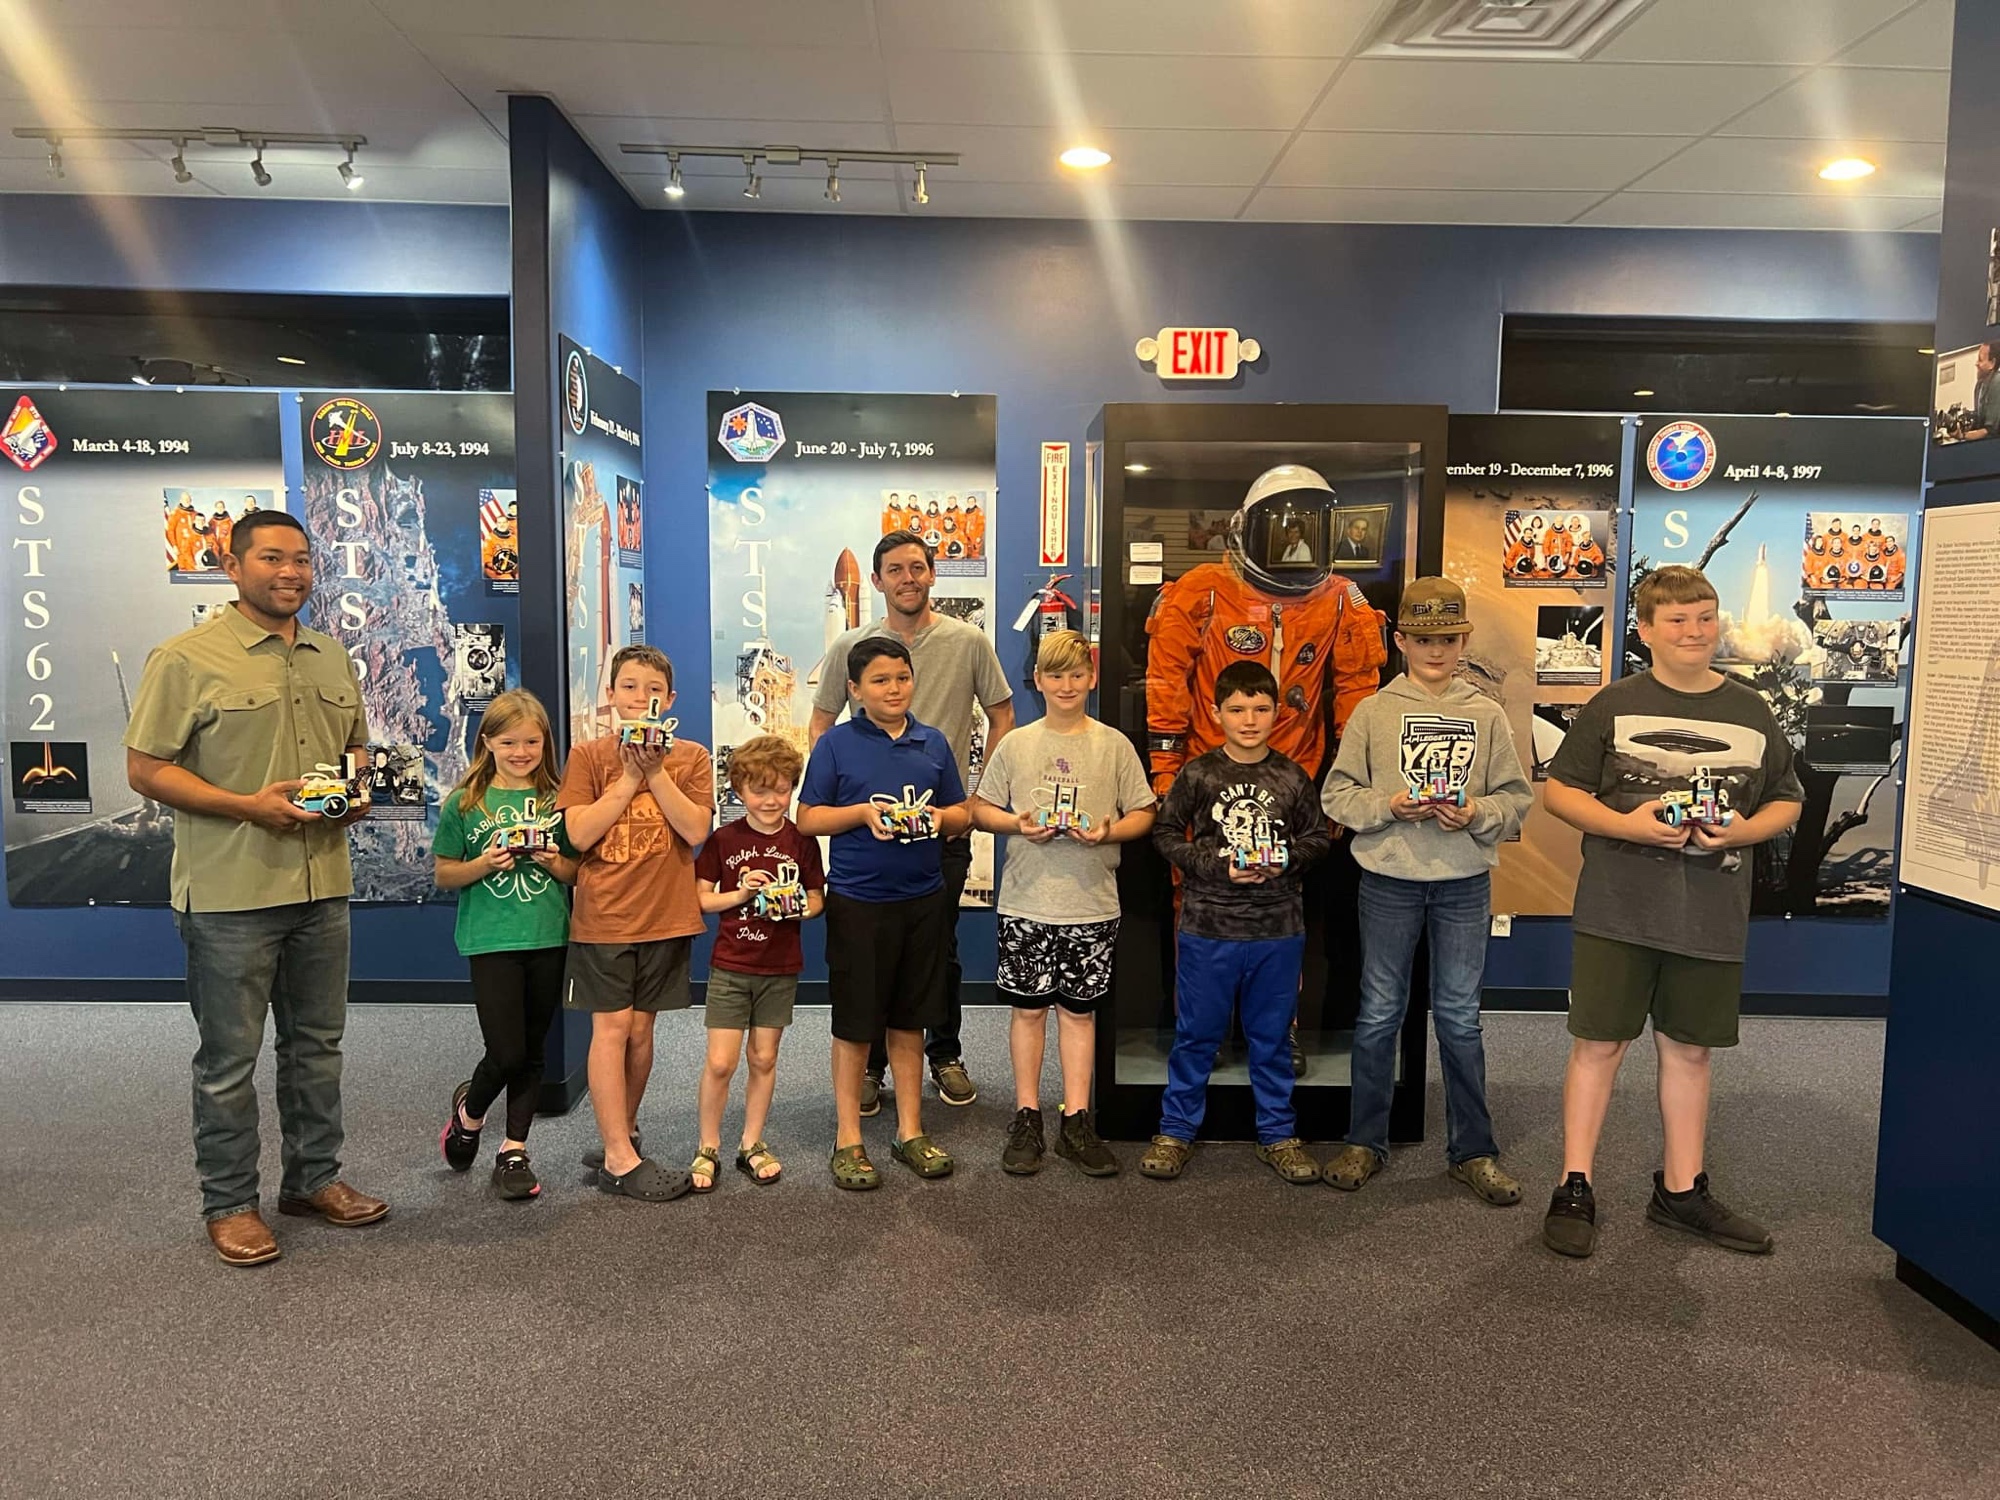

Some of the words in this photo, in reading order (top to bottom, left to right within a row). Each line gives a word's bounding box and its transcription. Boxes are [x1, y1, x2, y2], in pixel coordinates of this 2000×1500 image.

[1172, 331, 1228, 374] EXIT
[72, 438, 119, 453] March
[121, 439, 156, 455] 4-18,
[158, 439, 190, 454] 1994
[390, 441, 419, 459] July
[422, 441, 457, 457] 8-23,
[459, 441, 490, 456] 1994
[795, 441, 828, 458] June
[830, 441, 847, 455] 20
[858, 441, 887, 459] July
[889, 442, 901, 459] 7,
[904, 442, 934, 456] 1996
[1046, 452, 1064, 464] FIRE
[1446, 462, 1486, 476] ember
[1488, 462, 1501, 476] 19
[1510, 462, 1573, 477] December
[1574, 463, 1585, 479] 7,
[1587, 463, 1614, 477] 1996
[1723, 464, 1760, 482] April
[1762, 464, 1789, 481] 4-8,
[1791, 464, 1822, 479] 1997
[1050, 465, 1058, 558] EXTINGUISHER
[1043, 774, 1080, 784] BASEBALL
[1219, 783, 1258, 803] CAN'T
[1257, 789, 1276, 808] BE
[725, 845, 760, 870] Ralph
[736, 925, 769, 941] Polo
